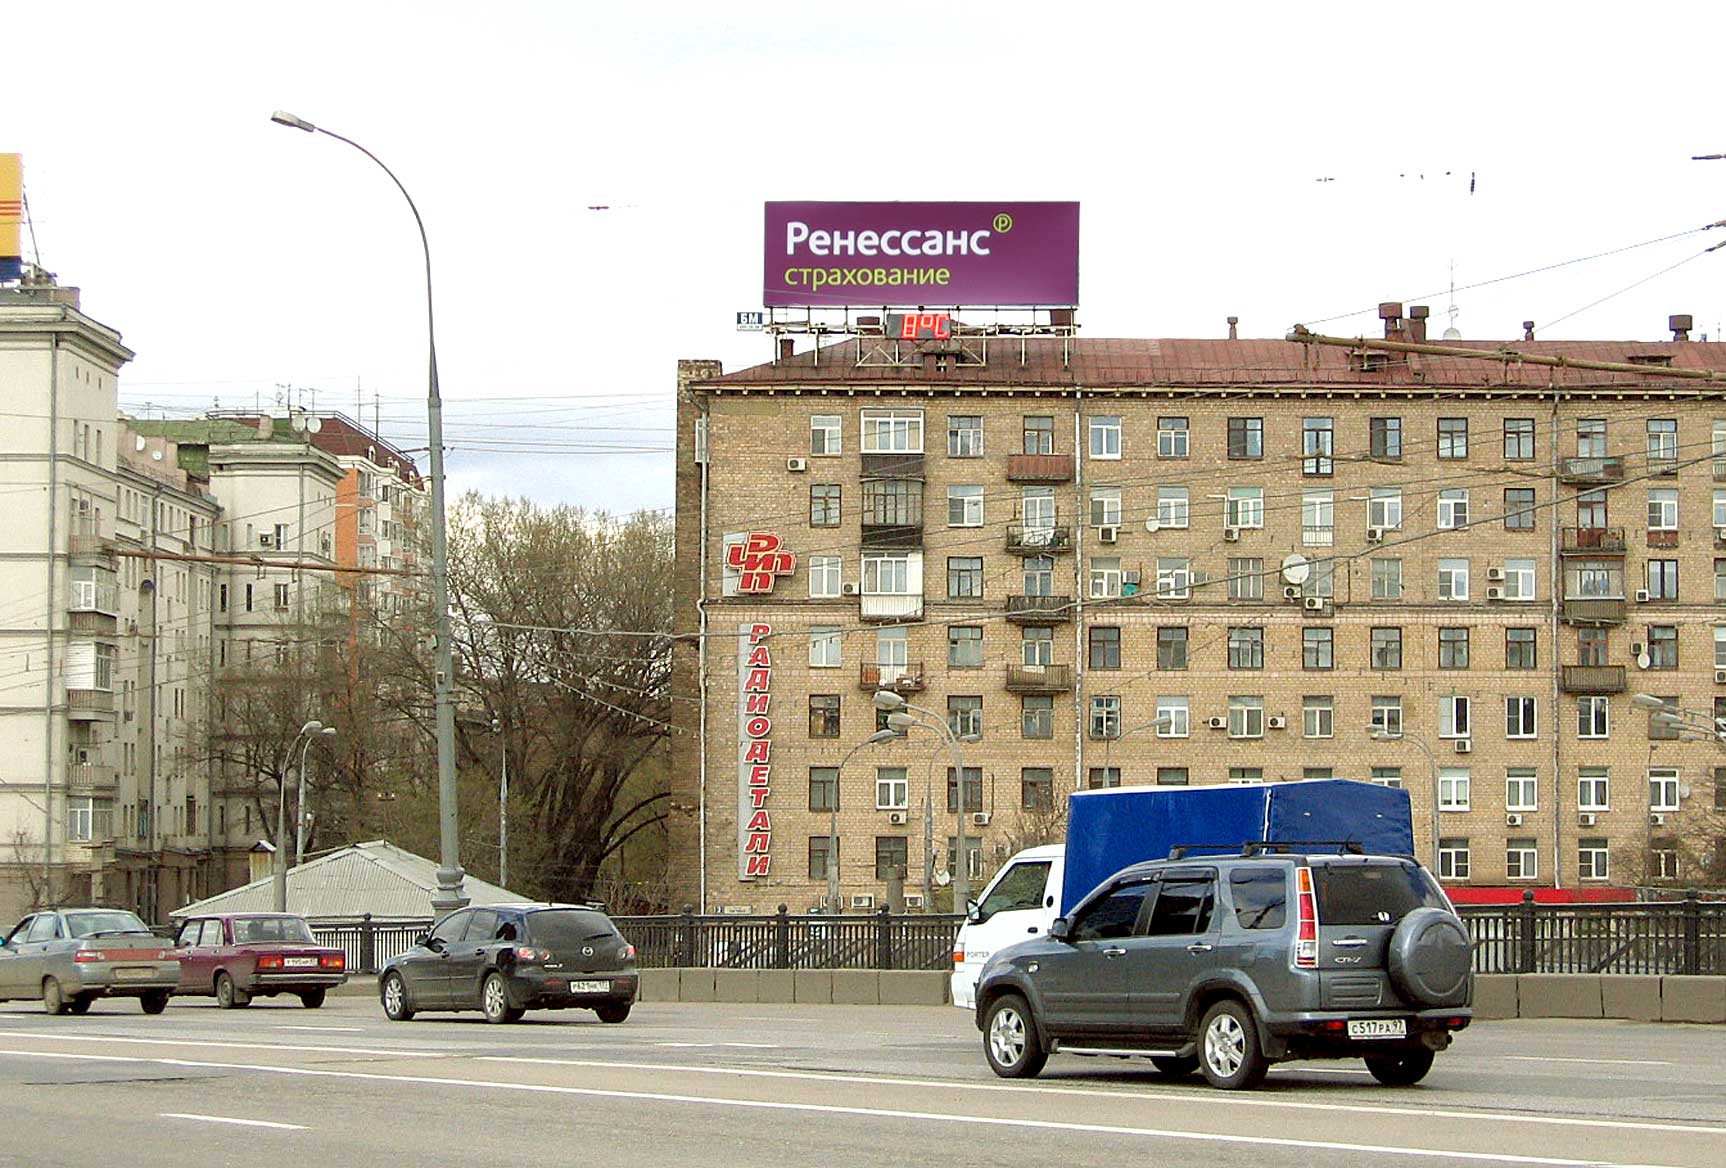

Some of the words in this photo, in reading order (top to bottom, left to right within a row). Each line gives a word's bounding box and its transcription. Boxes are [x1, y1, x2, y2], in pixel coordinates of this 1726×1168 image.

[786, 221, 991, 256] Ренессанс
[784, 267, 951, 292] страхование
[744, 622, 772, 877] РАДИОДЕТАЛИ
